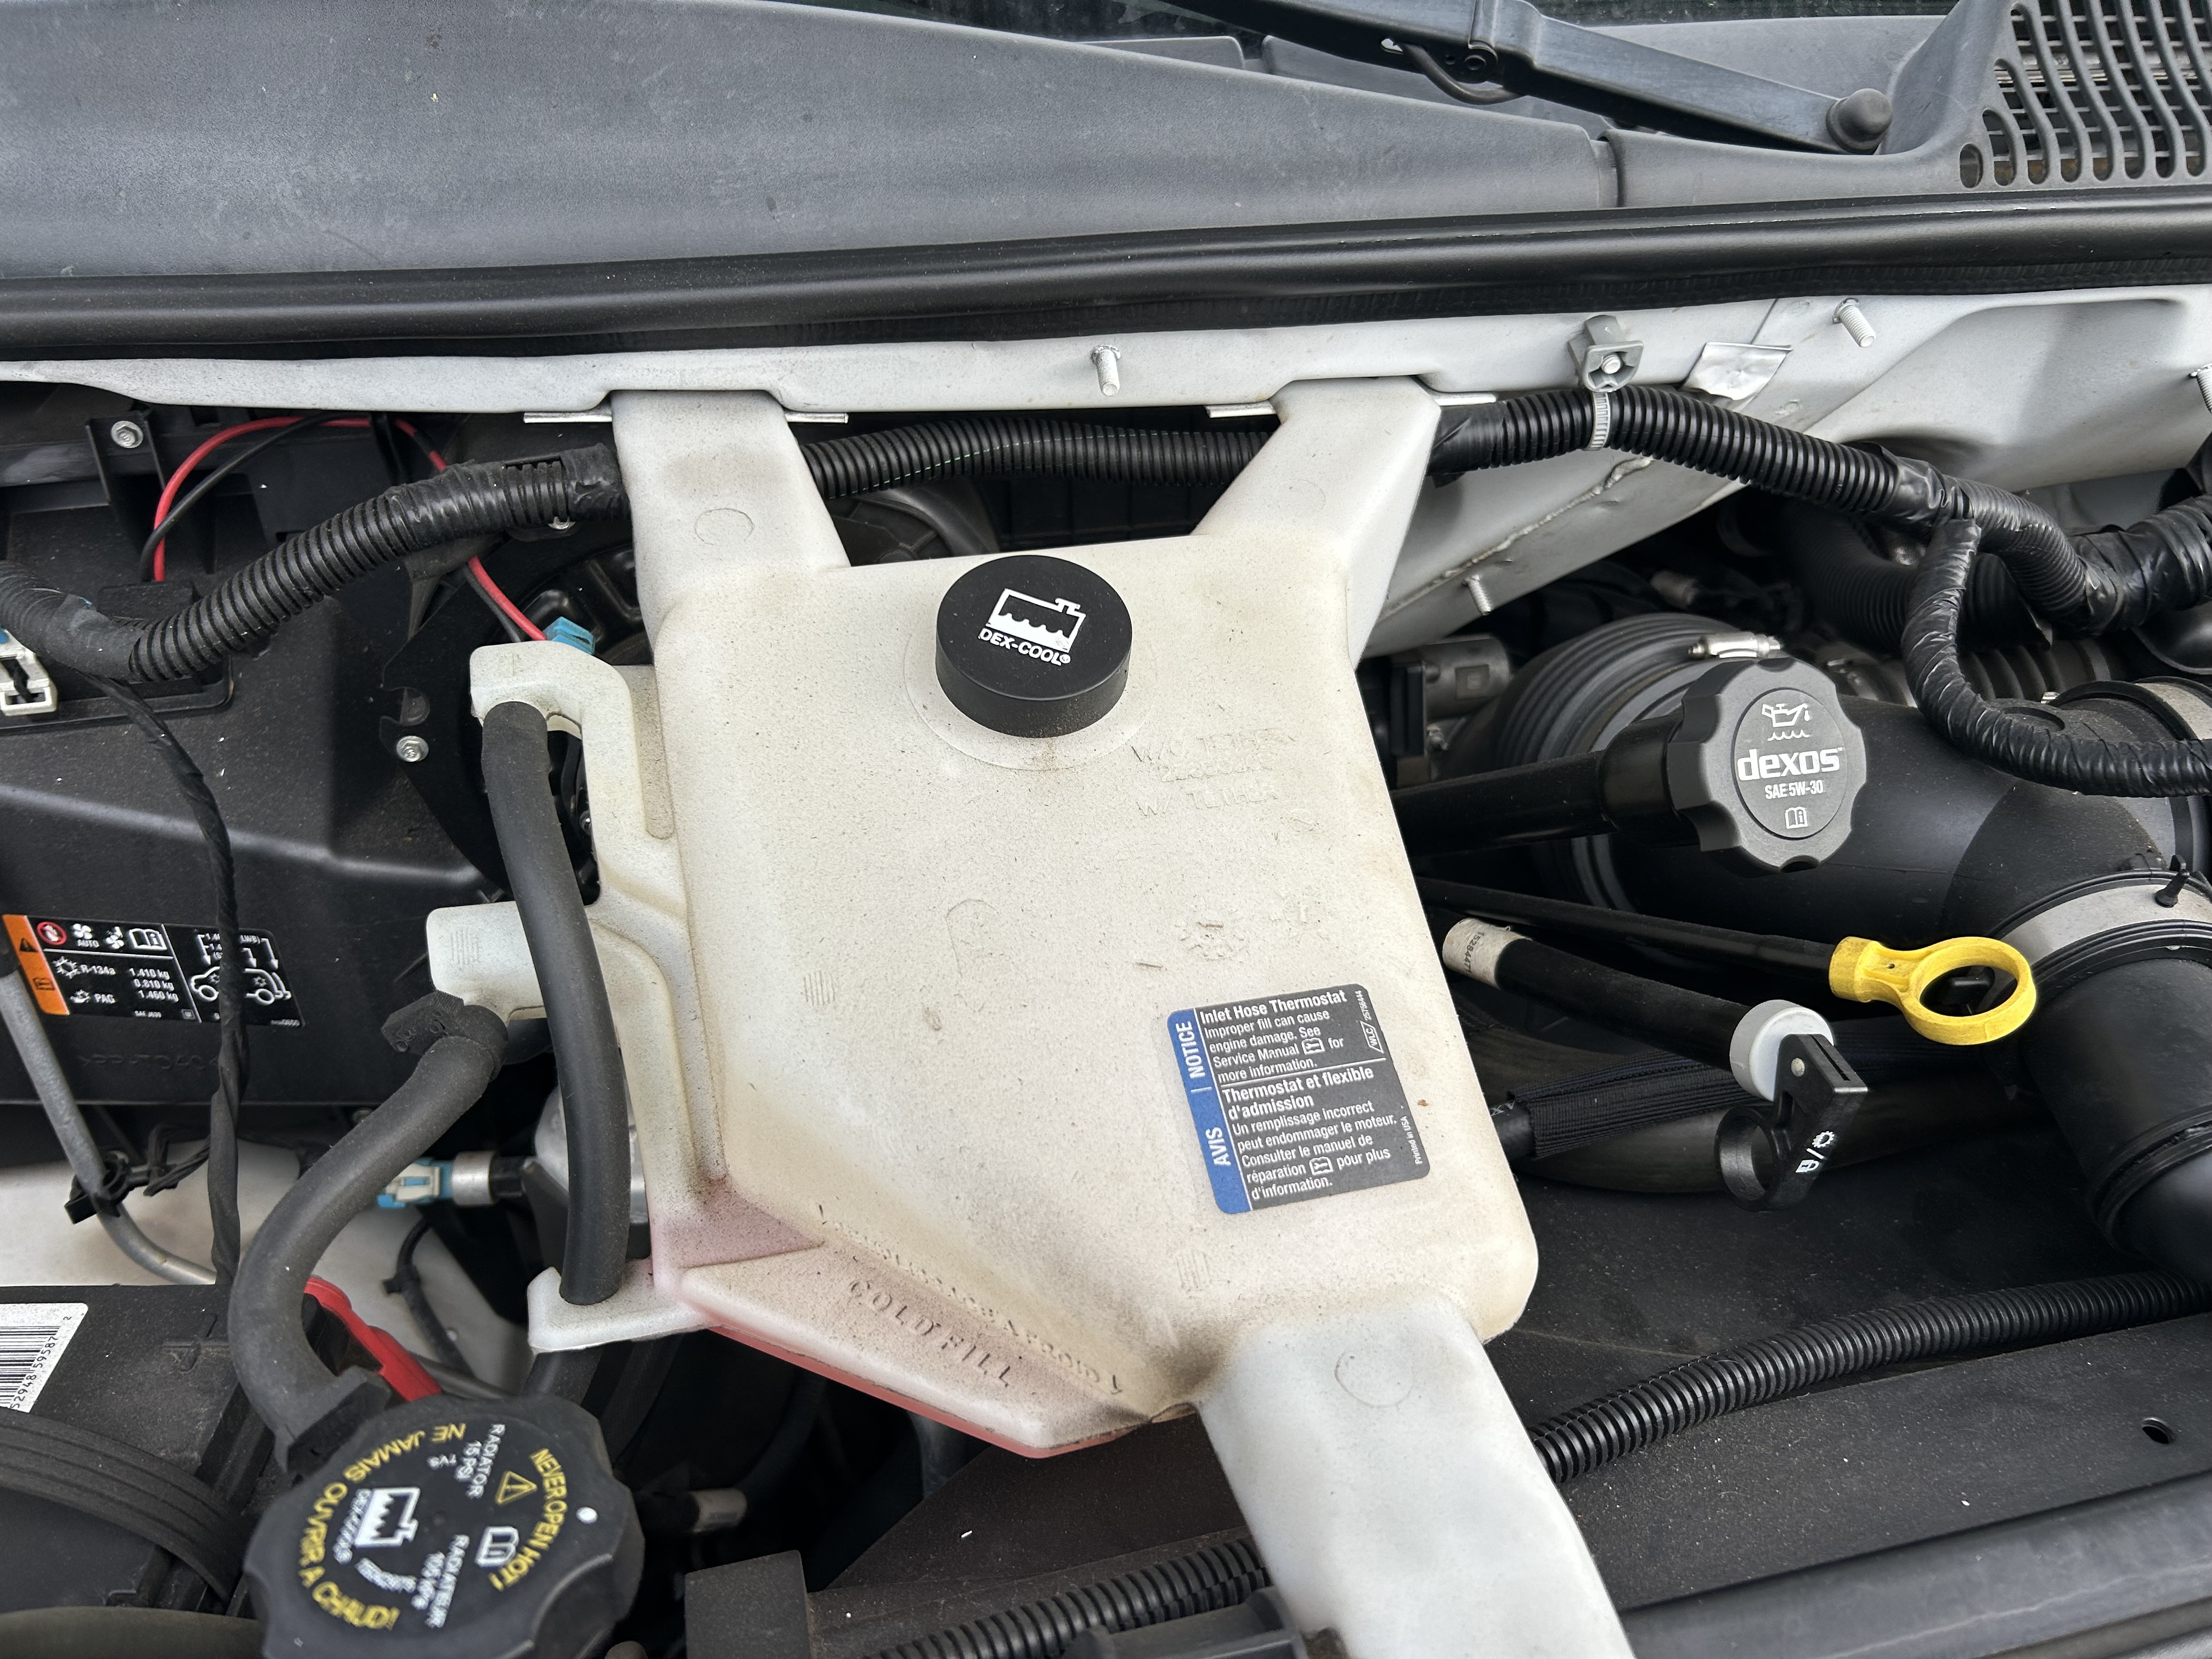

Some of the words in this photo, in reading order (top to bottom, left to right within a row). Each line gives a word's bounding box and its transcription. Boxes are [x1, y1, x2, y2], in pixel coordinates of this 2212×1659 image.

[1764, 783, 1787, 799] SAE
[1788, 780, 1824, 797] 5W-30
[77, 939, 99, 948] AUTO
[81, 964, 116, 975] R-134a
[128, 967, 156, 979] 1.410
[157, 969, 170, 980] kg
[162, 979, 175, 991] kg
[94, 993, 115, 1004] PAG
[165, 991, 179, 1003] kg
[1199, 1006, 1232, 1025] Inlet
[1233, 1003, 1267, 1020] Hose
[1268, 989, 1347, 1014] Thermostat
[1205, 1020, 1255, 1039] Improper
[1257, 1018, 1272, 1030] fill
[1274, 1016, 1295, 1028] can
[1297, 1010, 1330, 1023] cause
[1364, 1027, 1378, 1047] WLC
[1176, 1022, 1206, 1079] NOTICE
[1209, 1038, 1248, 1054] engine
[1249, 1032, 1297, 1048] damage.
[1299, 1026, 1321, 1038] See
[1212, 1052, 1256, 1068] Service
[1257, 1045, 1300, 1060] Manual
[1328, 1036, 1345, 1048] for
[1217, 1069, 1247, 1084] more
[1249, 1059, 1318, 1079] information.
[1222, 1080, 1303, 1104] Thermostat
[1306, 1075, 1321, 1088] et
[1323, 1066, 1374, 1086] flexible
[1228, 1093, 1314, 1120] d'admission
[1233, 1122, 1249, 1136] Un
[1251, 1111, 1321, 1135] remplissage
[1323, 1099, 1374, 1118] incorrect
[1237, 1138, 1263, 1152] peut
[1265, 1124, 1339, 1147] endommager
[1342, 1120, 1353, 1132] le
[1355, 1114, 1397, 1130] moteur.
[1400, 1116, 1411, 1130] USA
[1205, 1126, 1232, 1167] AVIS
[1242, 1148, 1296, 1168] Consulter
[1299, 1145, 1310, 1158] le
[1313, 1136, 1356, 1154] manuel
[1358, 1132, 1373, 1145] de
[1406, 1137, 1423, 1165] Printed
[1246, 1161, 1306, 1184] réparation
[1336, 1155, 1365, 1170] pour
[1367, 1147, 1391, 1162] plus
[1250, 1176, 1333, 1200] d'information.
[849, 1278, 943, 1337] COLD
[939, 1333, 1012, 1387] FILL
[10, 1374, 37, 1409] 52948
[33, 1336, 59, 1368] 59587
[432, 1423, 466, 1442] NE
[344, 1430, 426, 1482] JAMAIS
[464, 1441, 482, 1458] 15
[466, 1423, 506, 1499] RADIATOR
[454, 1455, 479, 1480] PSI
[530, 1448, 567, 1501] NEVER
[300, 1483, 348, 1566] OUVRIR
[528, 1499, 567, 1550] OPEN
